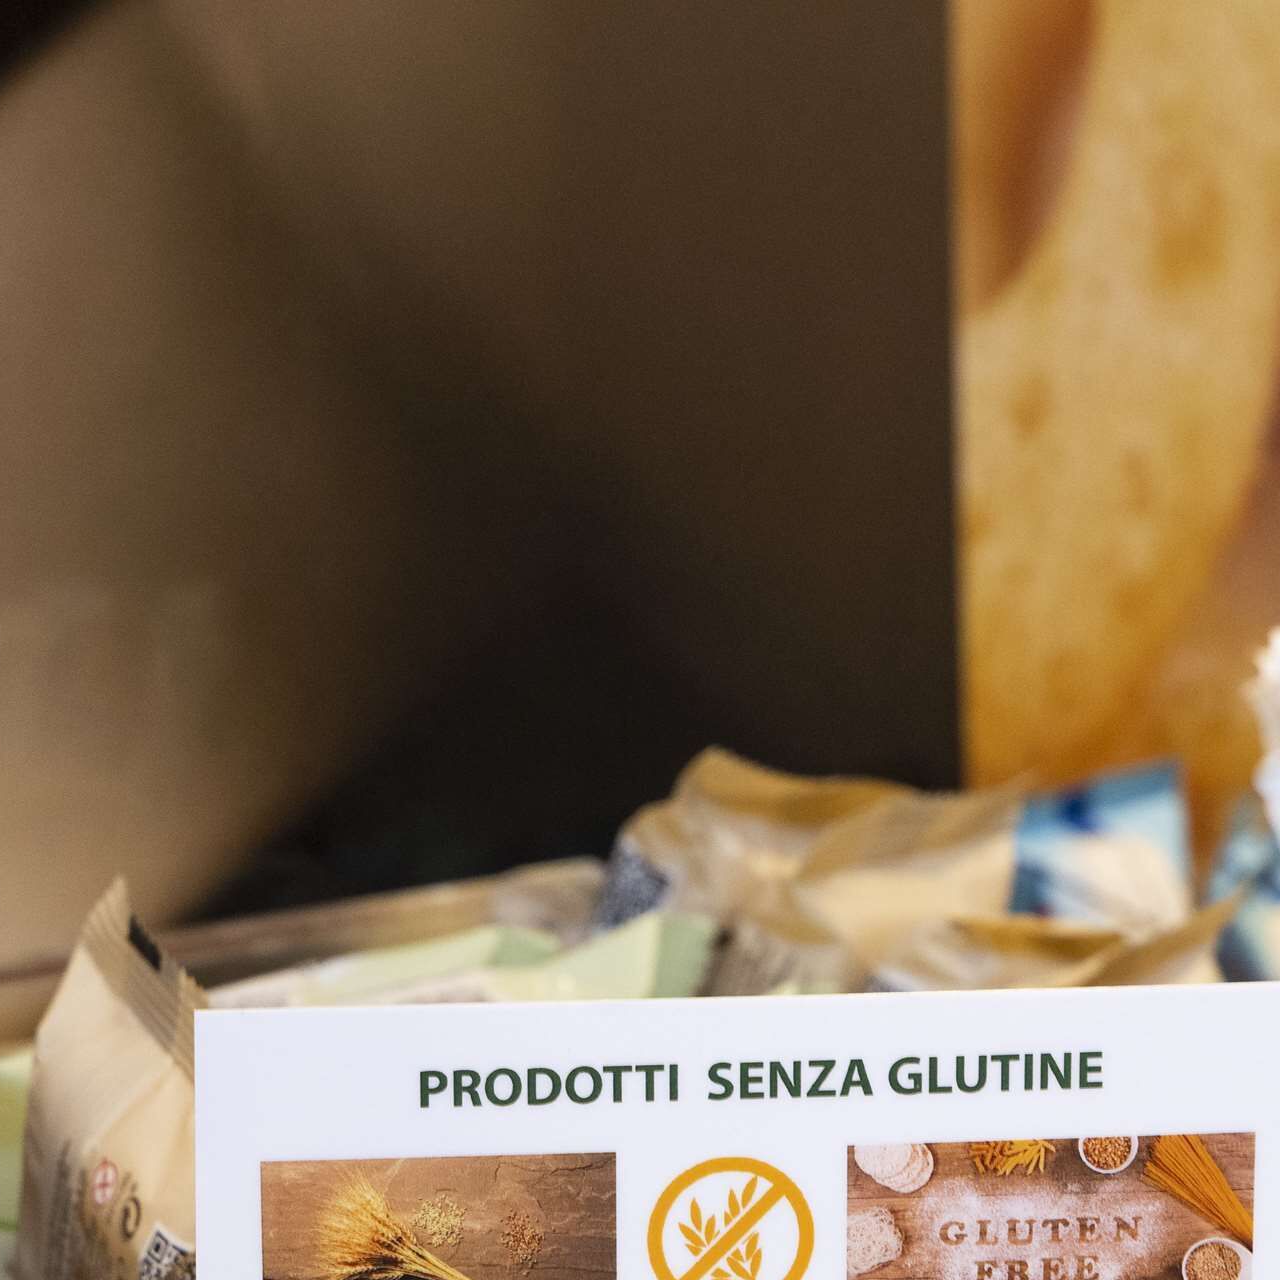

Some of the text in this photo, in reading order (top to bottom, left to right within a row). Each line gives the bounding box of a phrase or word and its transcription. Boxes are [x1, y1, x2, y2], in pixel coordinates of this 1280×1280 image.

[418, 1051, 1103, 1109] PRODOTTI SENZA GLUTINE
[938, 1215, 1144, 1248] GLUTEN
